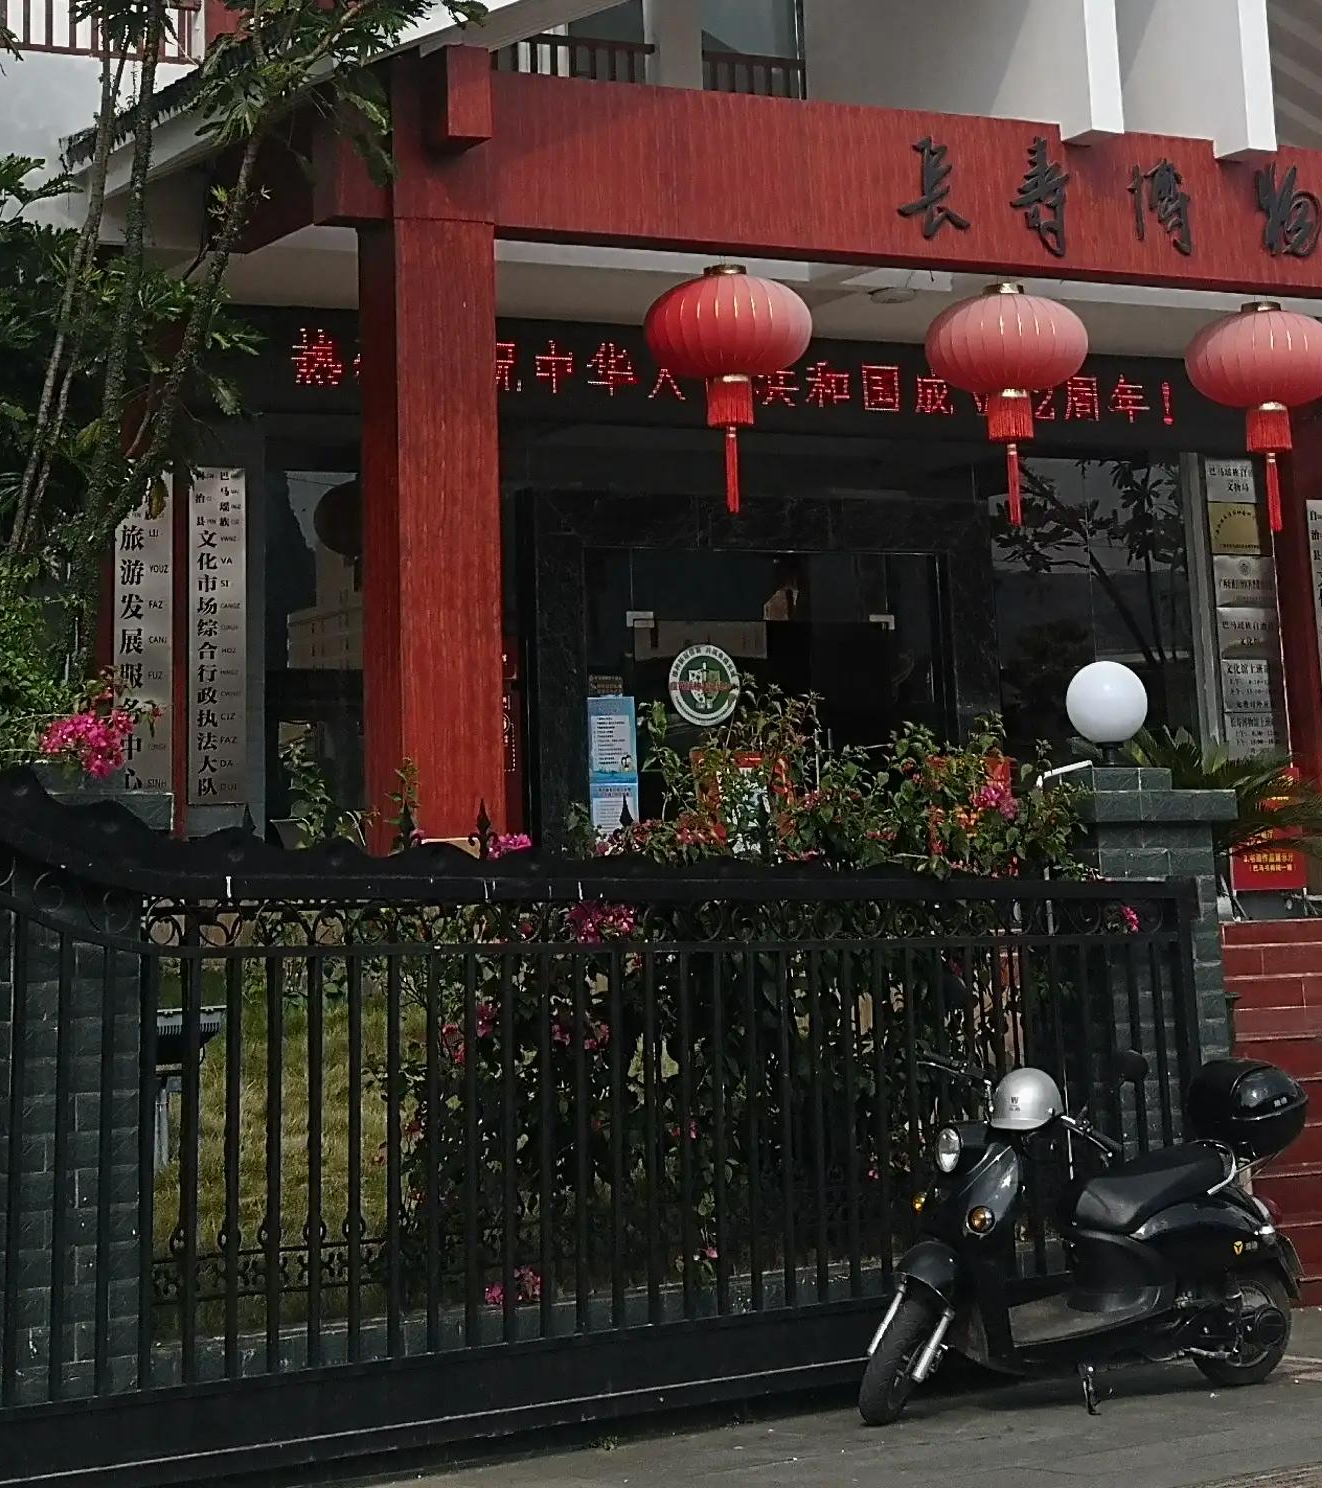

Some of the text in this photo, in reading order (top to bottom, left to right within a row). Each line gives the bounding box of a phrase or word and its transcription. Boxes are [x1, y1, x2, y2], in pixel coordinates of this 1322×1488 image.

[196, 530, 218, 797] 文化市场综合行政执法大队
